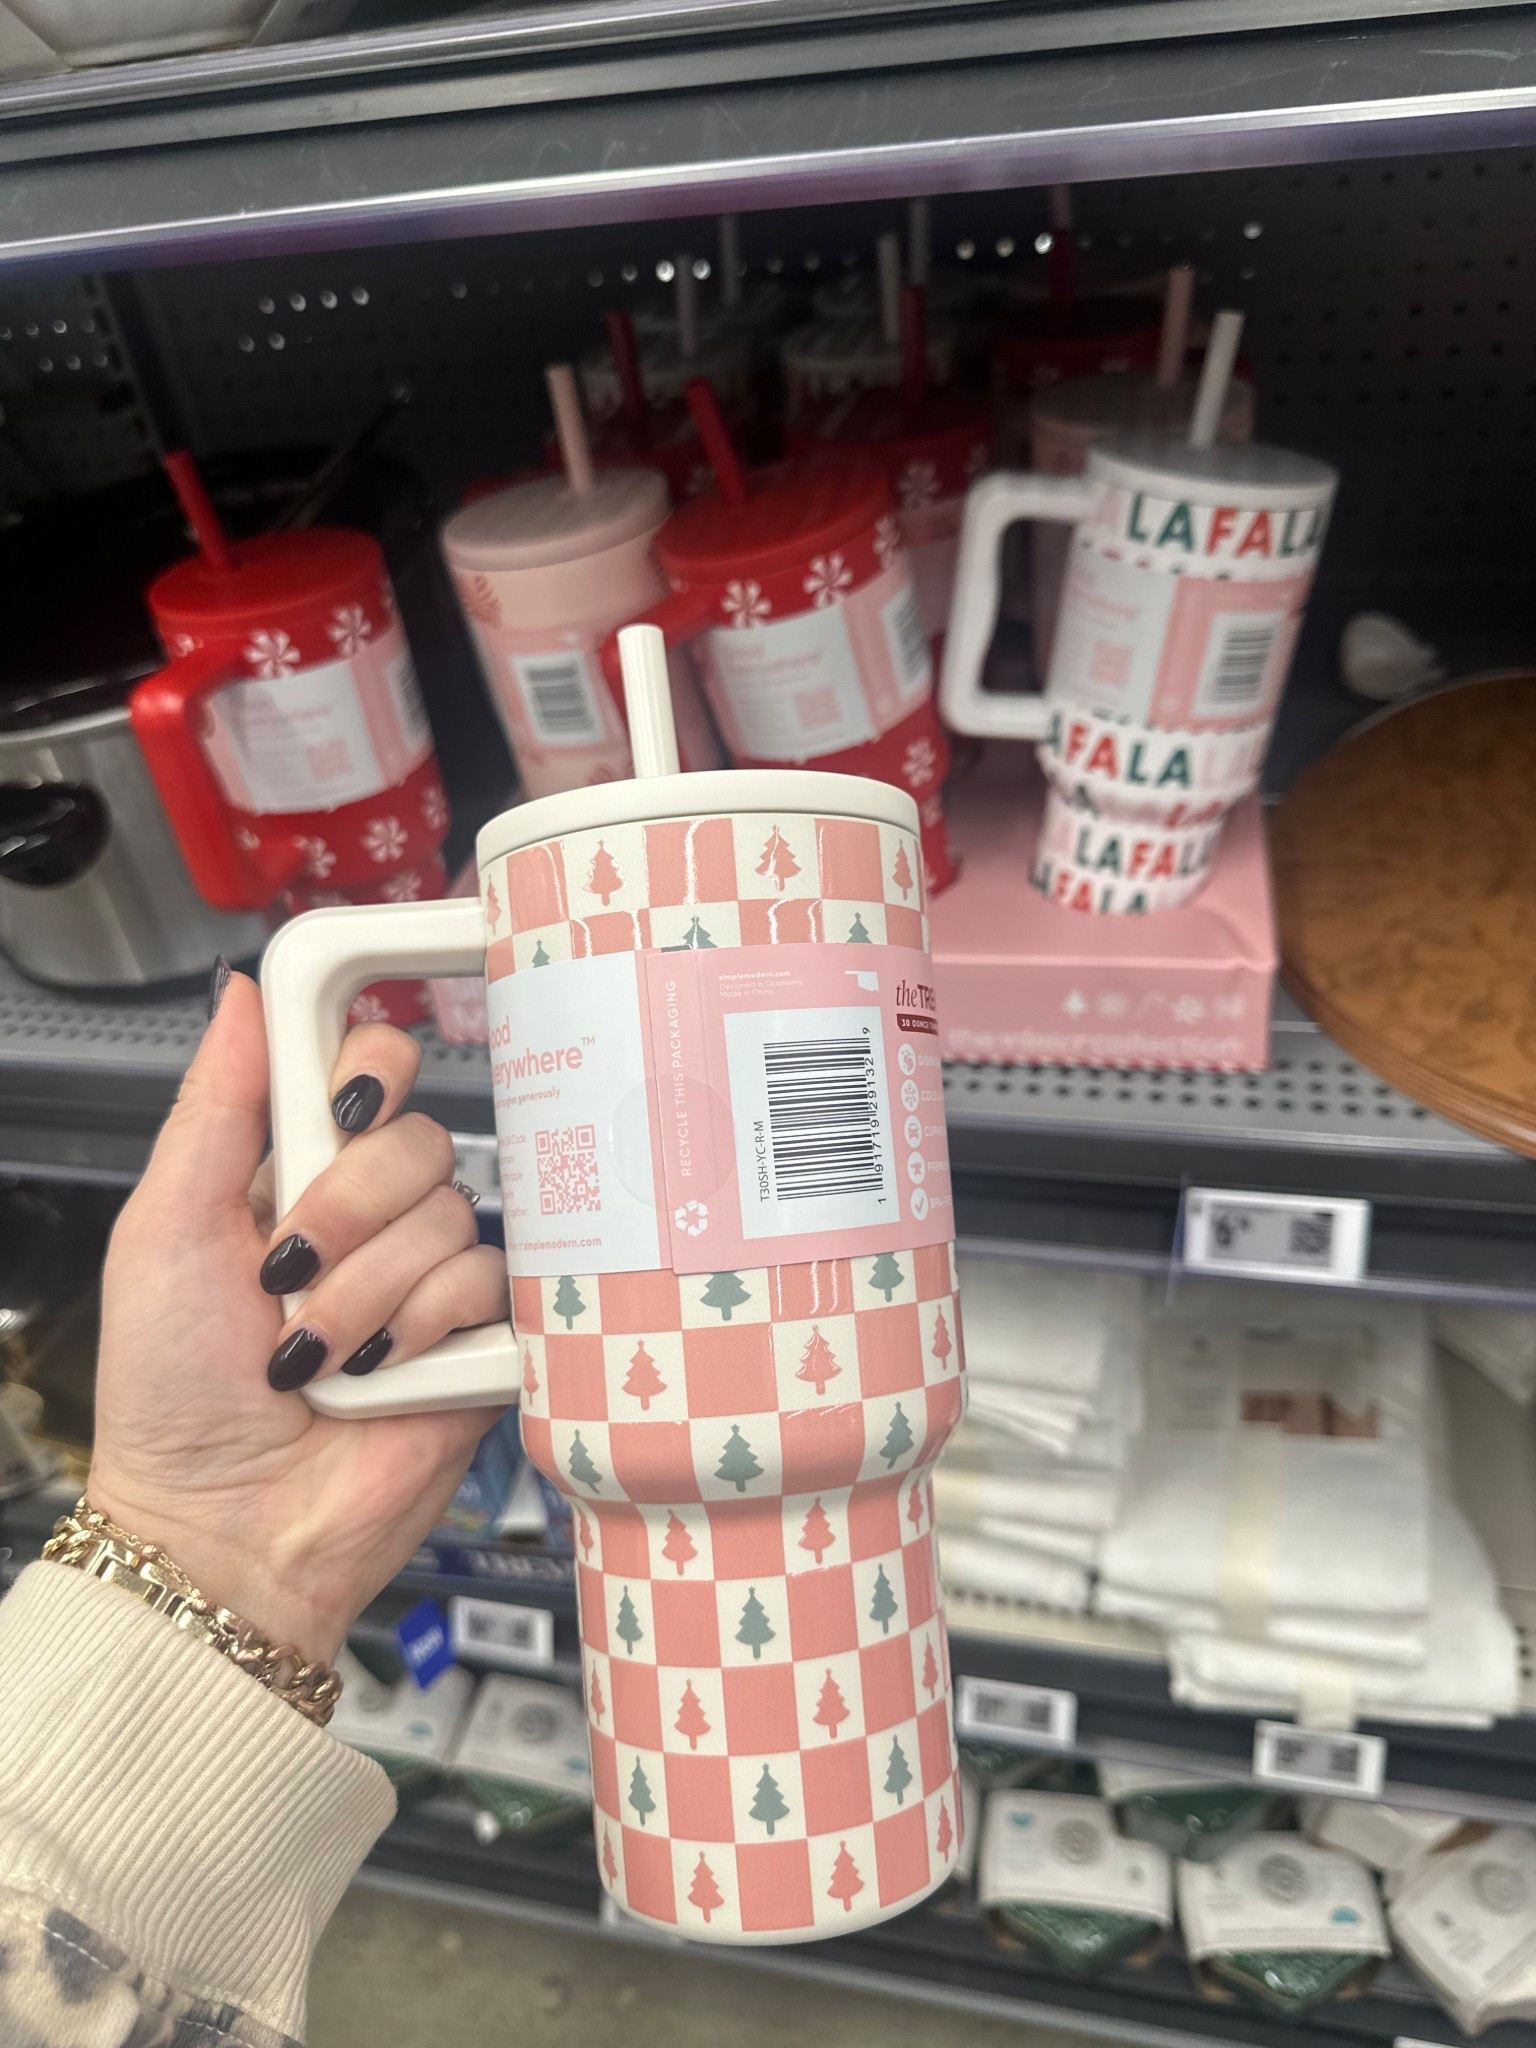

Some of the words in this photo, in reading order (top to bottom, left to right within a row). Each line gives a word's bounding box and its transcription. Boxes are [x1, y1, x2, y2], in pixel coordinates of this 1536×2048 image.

[719, 971, 790, 981] simplemodern.com
[665, 980, 682, 1068] PACKAGING
[862, 1027, 871, 1035] 9
[901, 1018, 910, 1027] 30
[518, 1087, 561, 1105] generously
[672, 1072, 686, 1106] THIS
[864, 1057, 878, 1110] 29132
[676, 1111, 692, 1176] RECYCLE
[870, 1119, 884, 1172] 91719
[753, 1120, 770, 1202] T30SH-YC-R-M
[524, 1237, 602, 1252] simplemodern.com
